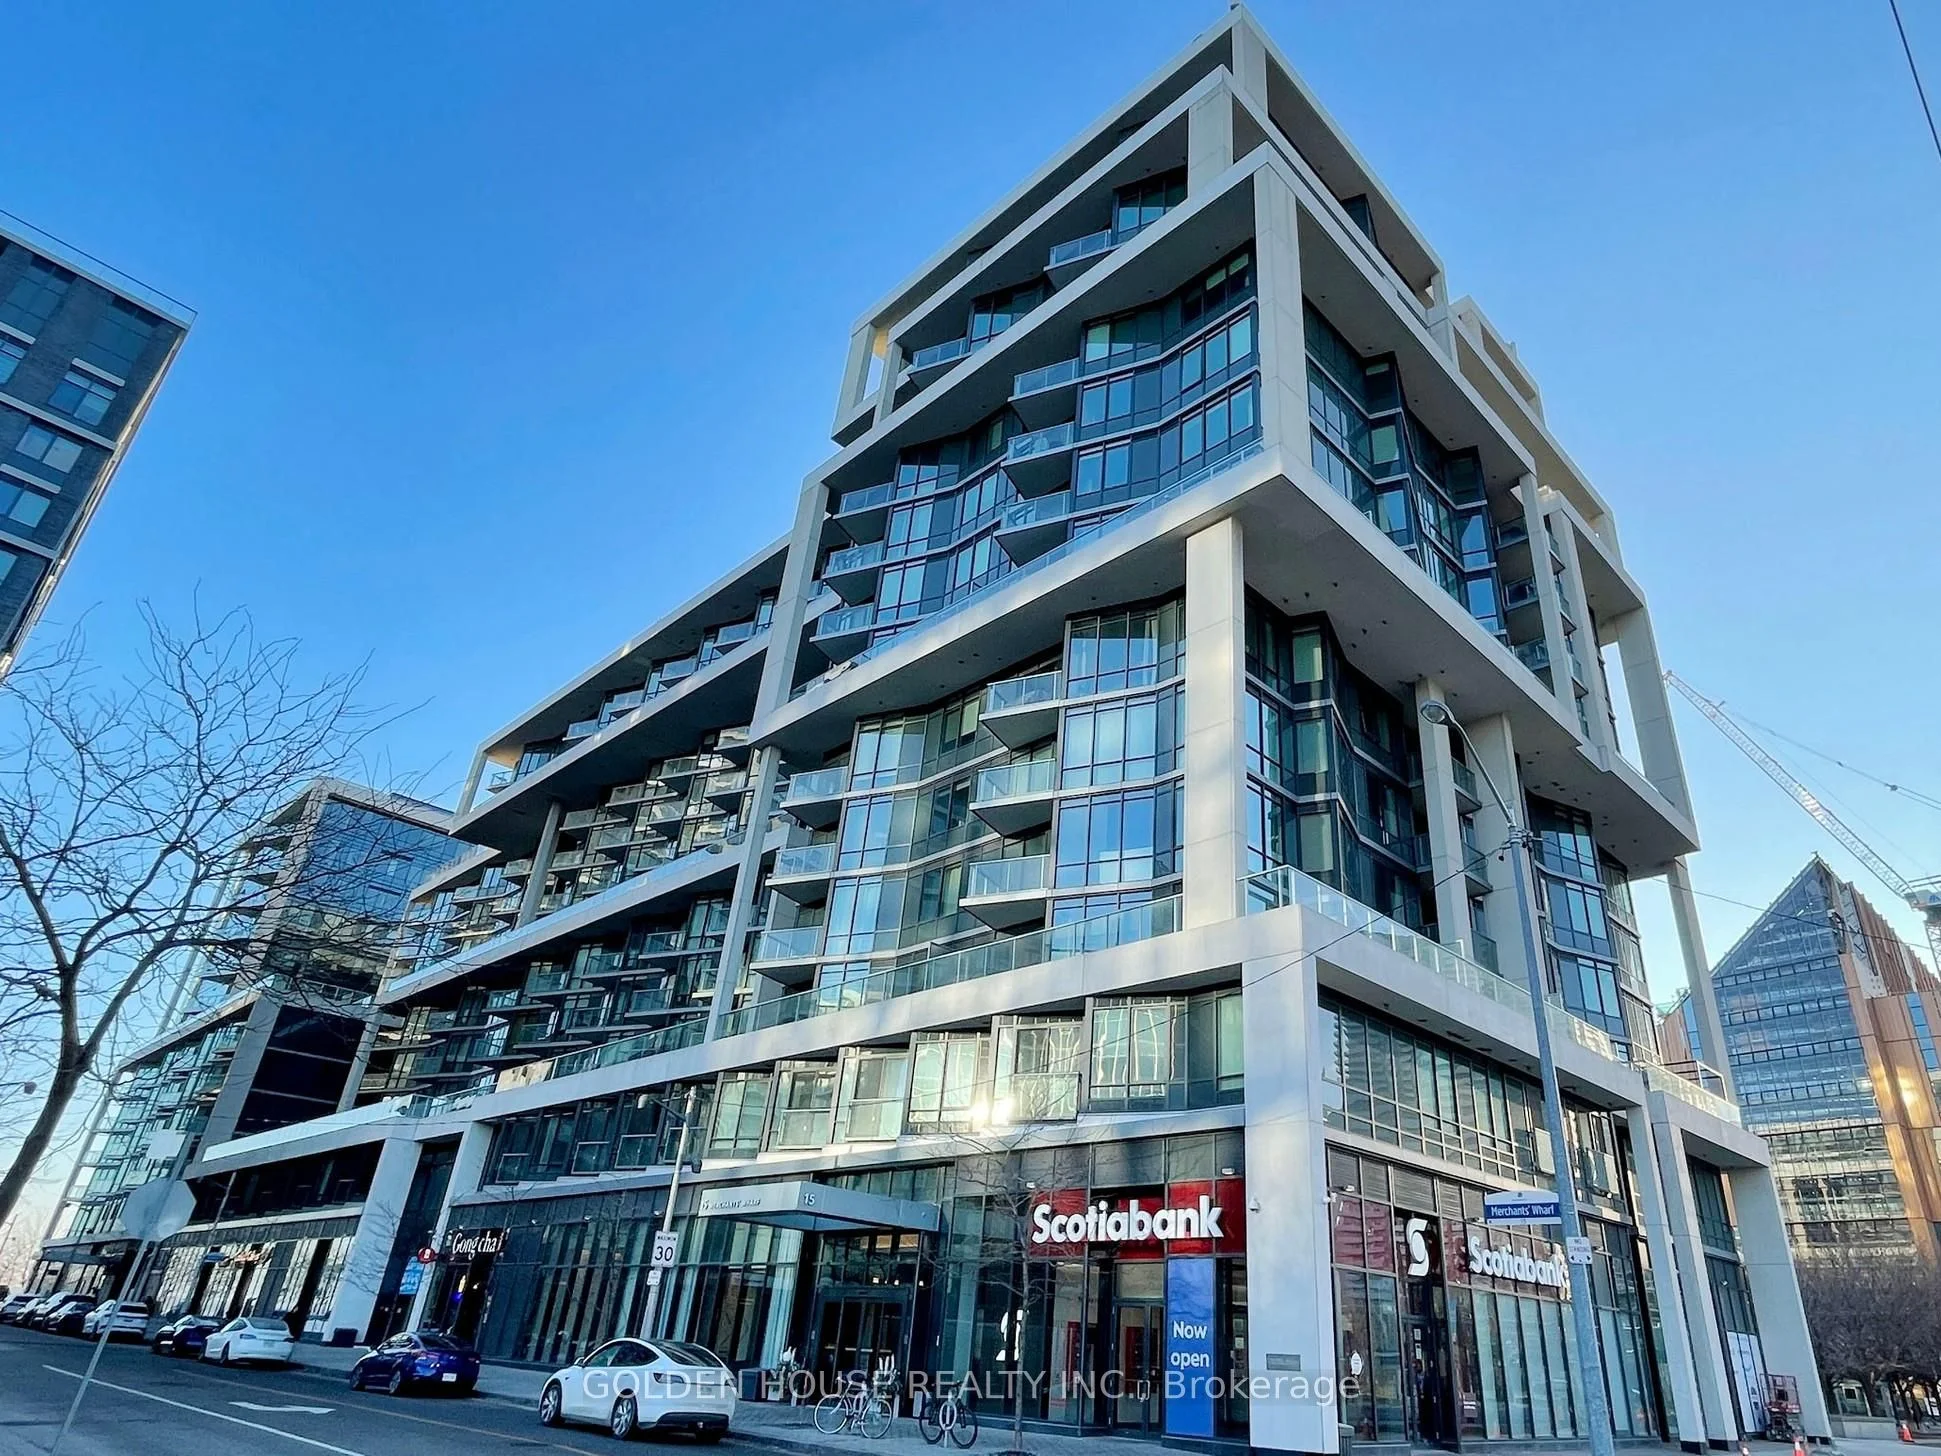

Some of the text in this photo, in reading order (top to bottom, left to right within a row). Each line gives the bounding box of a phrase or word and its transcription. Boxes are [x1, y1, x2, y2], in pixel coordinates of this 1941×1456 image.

[803, 1193, 815, 1206] 15
[1032, 1195, 1224, 1244] Scotiabank
[1491, 1204, 1554, 1217] Merchants' Wharf
[452, 1233, 480, 1260] Gong
[478, 1231, 497, 1252] cha
[655, 1246, 673, 1261] 30
[1469, 1236, 1568, 1291] Scotiabank
[1173, 1321, 1207, 1339] Now
[1170, 1352, 1210, 1370] open
